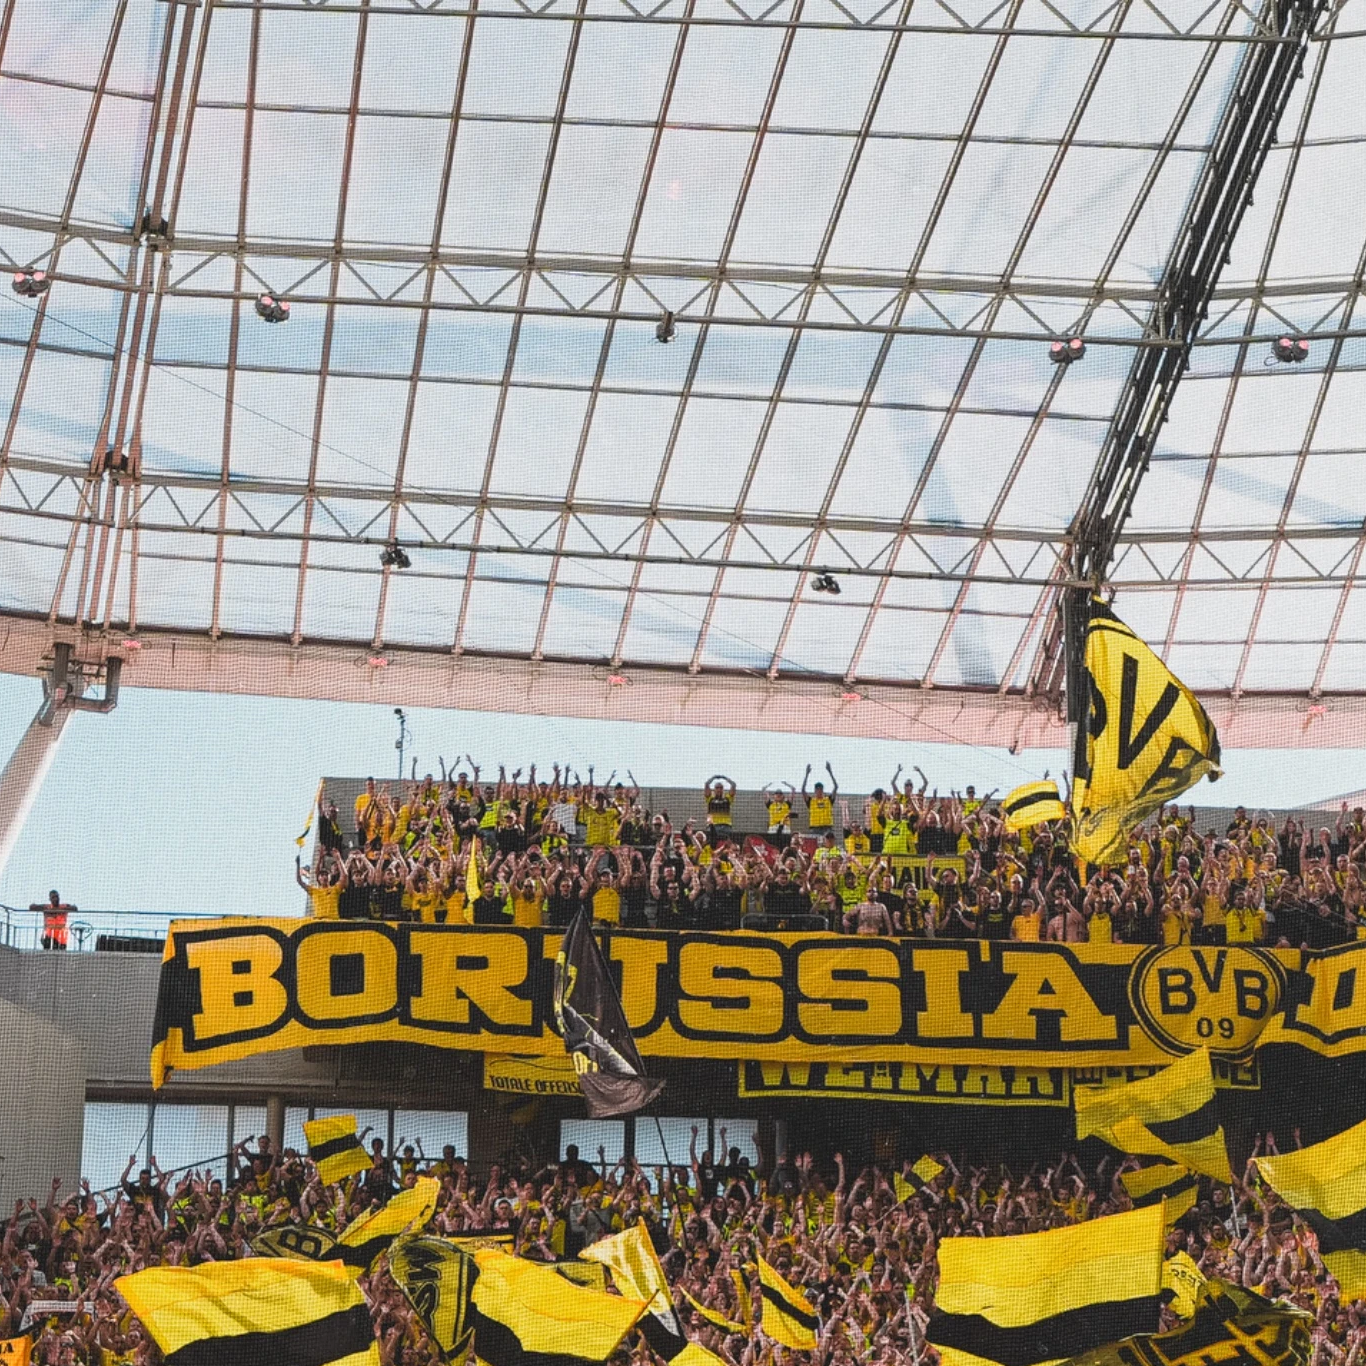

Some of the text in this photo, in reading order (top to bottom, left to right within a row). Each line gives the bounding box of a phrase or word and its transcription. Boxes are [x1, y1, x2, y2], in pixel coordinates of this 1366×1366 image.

[1159, 948, 1269, 1020] BVB
[1197, 1016, 1235, 1040] 09
[490, 1075, 531, 1091] TOTALE
[758, 1061, 1055, 1097] WEIMAR
